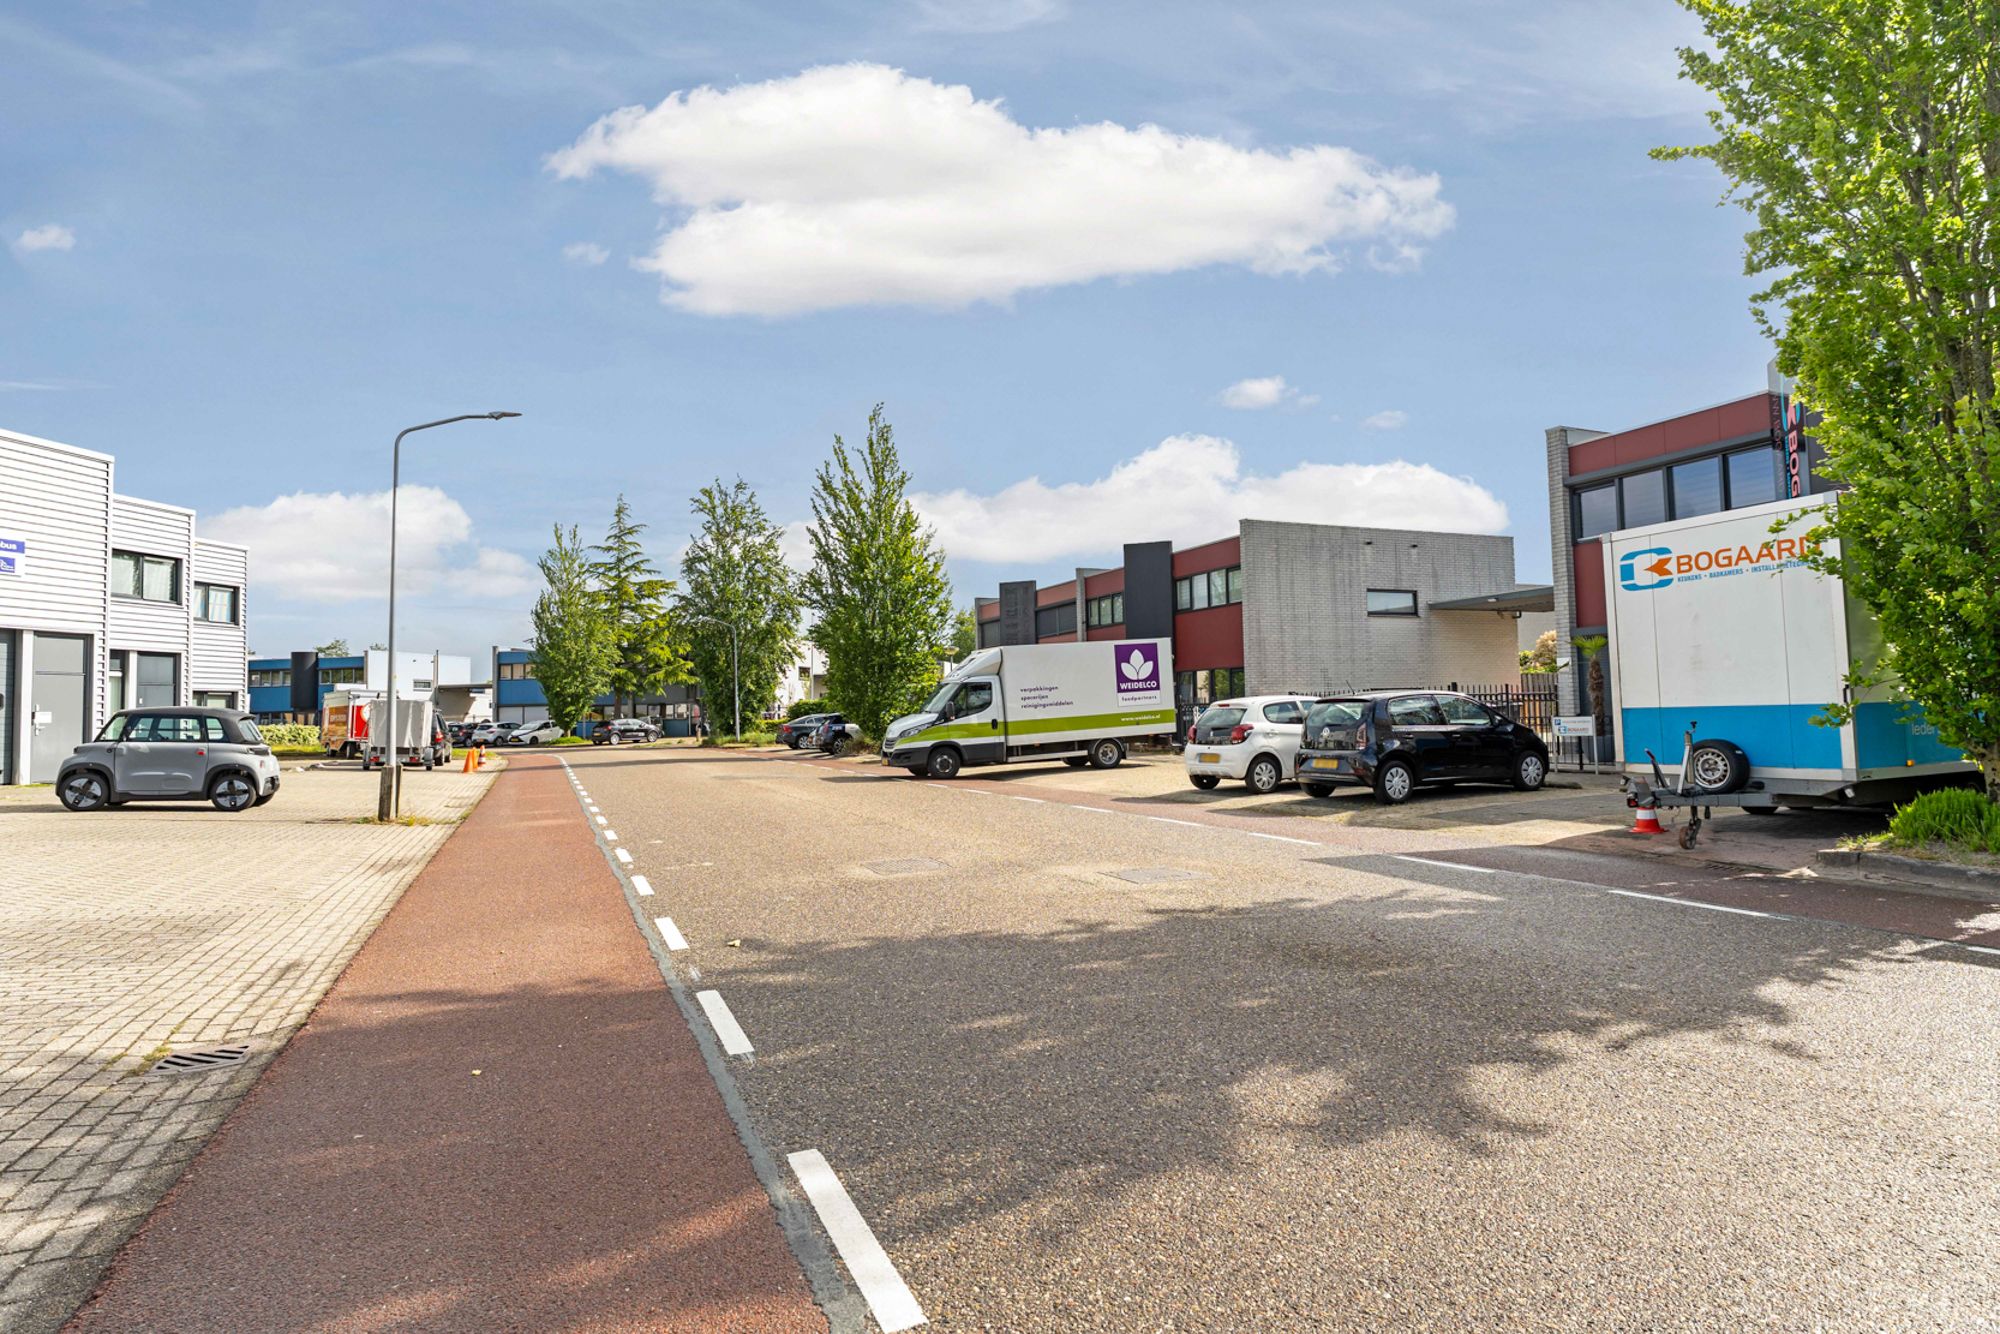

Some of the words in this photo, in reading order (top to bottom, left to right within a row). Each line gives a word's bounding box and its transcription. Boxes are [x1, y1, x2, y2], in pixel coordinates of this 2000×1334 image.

[1709, 568, 1744, 578] BADKAMERS
[1020, 685, 1058, 693] verpakkingen
[1119, 680, 1157, 690] WEIDELCO
